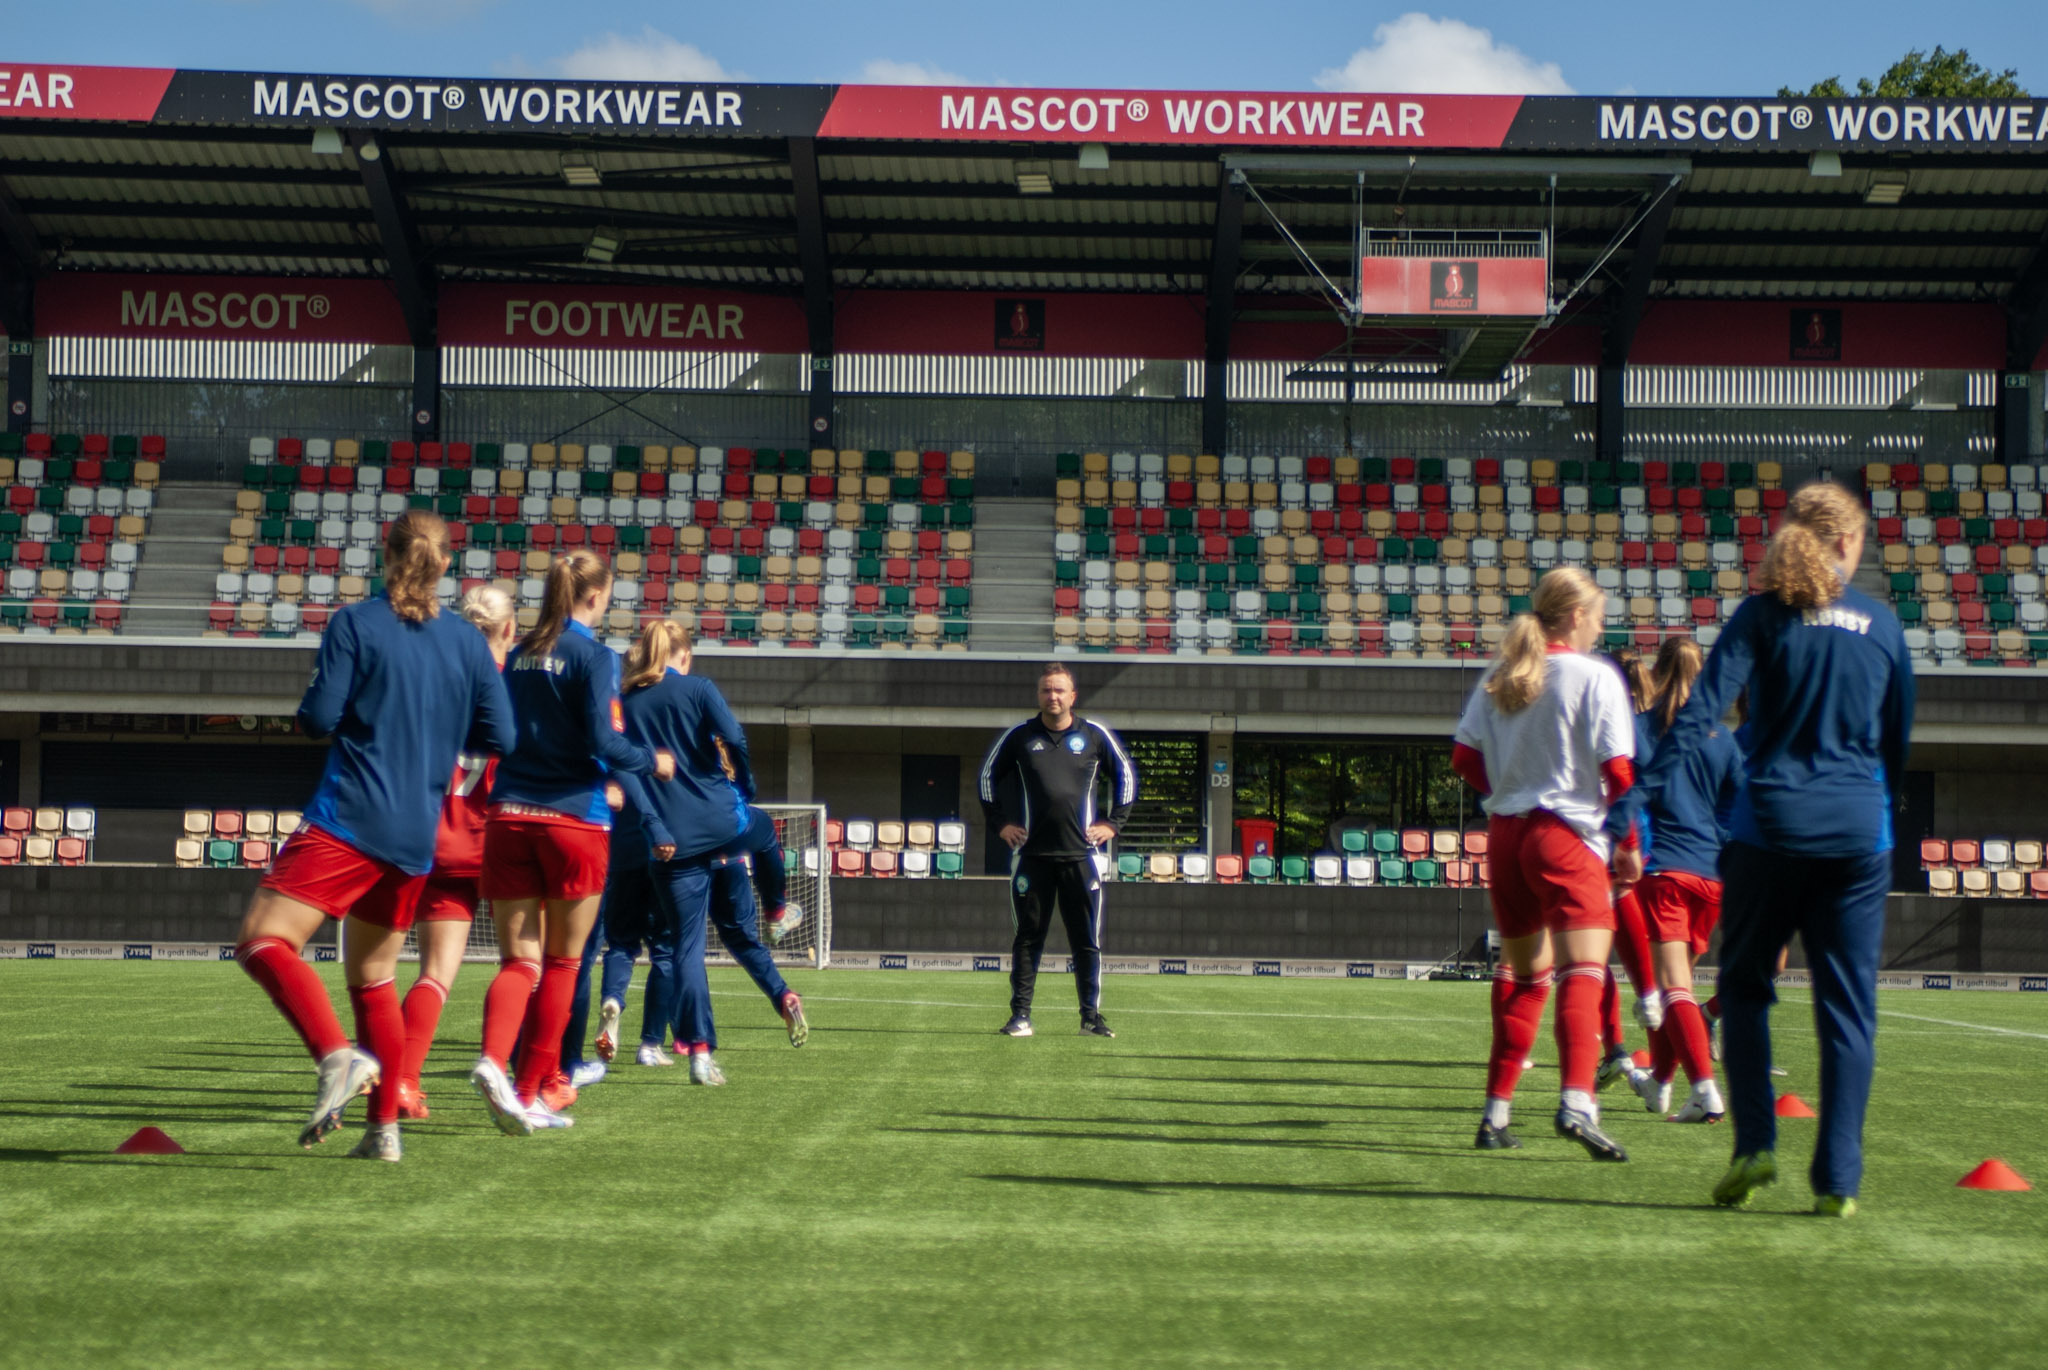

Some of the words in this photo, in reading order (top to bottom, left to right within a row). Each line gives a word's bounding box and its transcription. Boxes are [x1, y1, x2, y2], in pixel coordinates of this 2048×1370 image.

[253, 80, 466, 121] MASCOT®
[479, 87, 743, 127] WORKWEAR
[941, 94, 1150, 132] MASCOT®
[1163, 99, 1426, 138] WORKWEAR
[1600, 103, 1813, 141] MASCOT®
[1434, 298, 1473, 308] MASCOT
[121, 289, 331, 330] MASCOT®
[505, 300, 745, 341] FOOTWEAR
[1211, 773, 1230, 788] D3
[32, 945, 55, 956] JYSK
[70, 947, 88, 957] godt
[89, 946, 113, 956] tilbud
[129, 946, 151, 956] JYSK
[167, 947, 185, 958] godt
[186, 947, 209, 957] tilbud
[847, 957, 869, 967] tilbud
[885, 956, 907, 967] JYSK
[921, 959, 938, 970] godt
[940, 958, 963, 968] tilbud
[978, 958, 1000, 969] JYSK
[1108, 963, 1126, 973] godt
[1126, 962, 1149, 971] tilbud
[1164, 962, 1186, 973] JYSK
[1201, 964, 1218, 974] godt
[1219, 963, 1242, 973] tilbud
[1257, 964, 1280, 974] JYSK
[1295, 966, 1312, 977] godt
[1313, 965, 1336, 975] tilbud
[1351, 965, 1374, 976] JYSK
[1889, 976, 1912, 986] tilbud
[1928, 977, 1951, 988] JYSK
[1965, 978, 1983, 989] godt
[1984, 978, 2008, 988] tilbud
